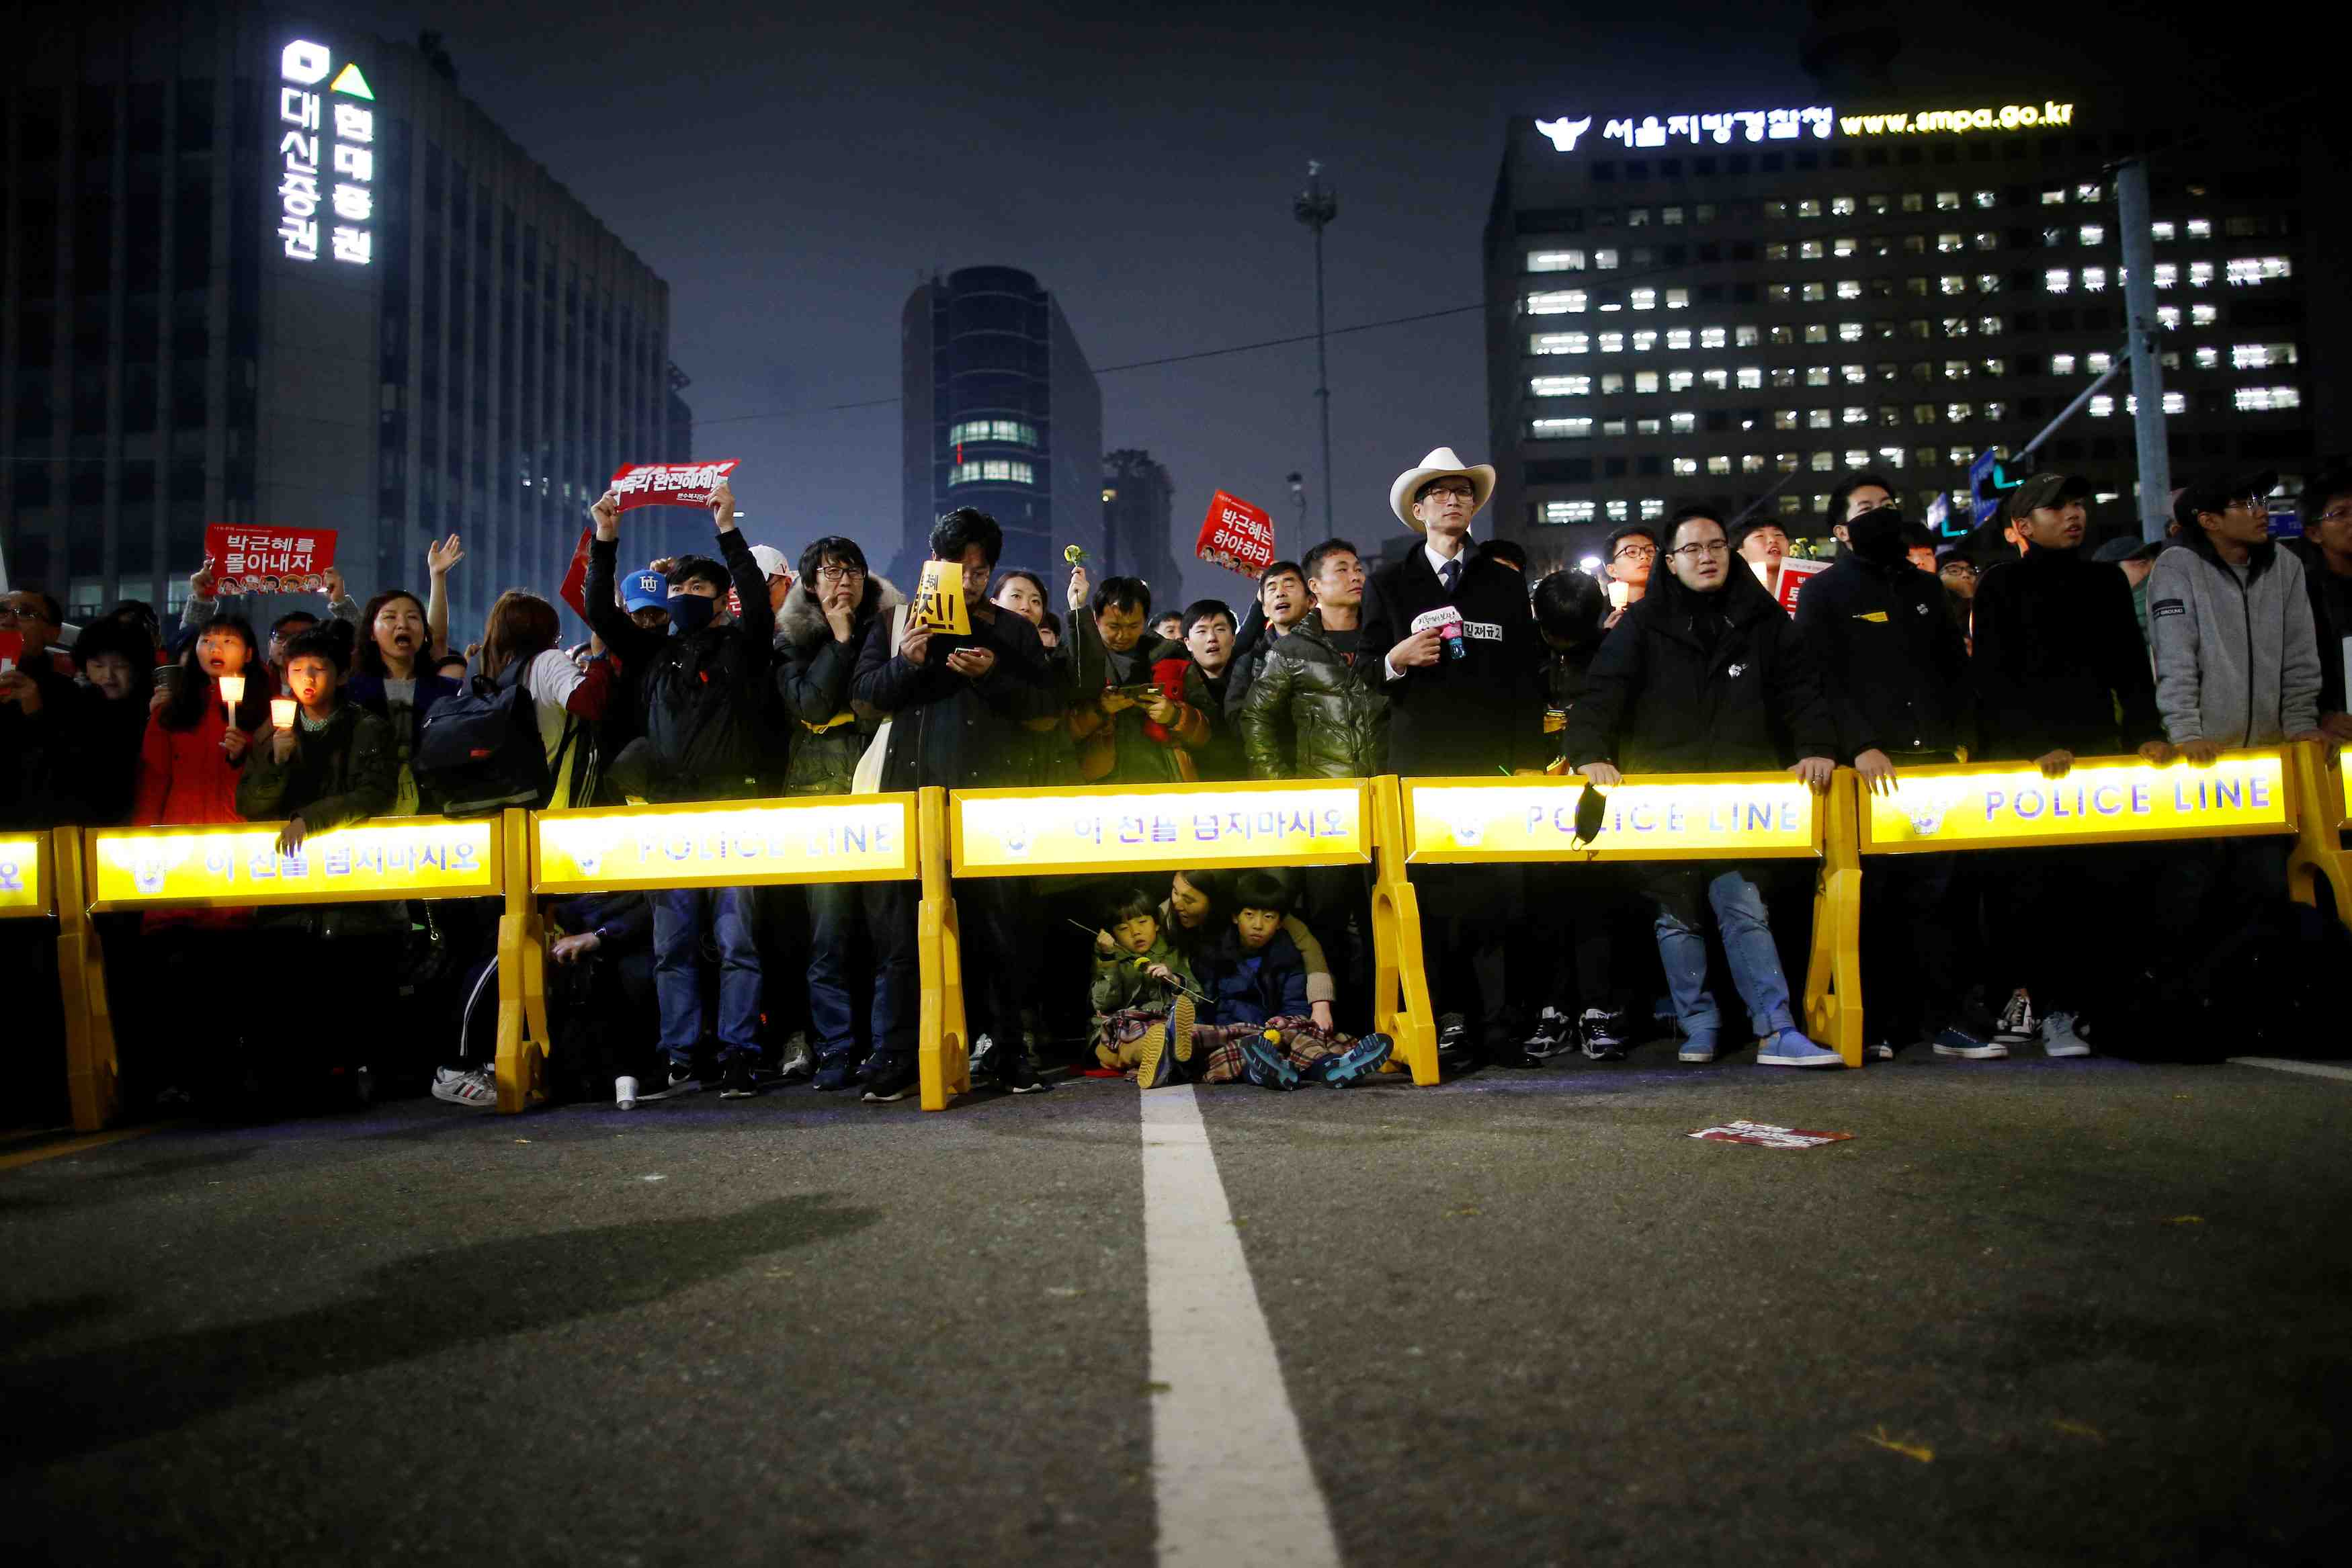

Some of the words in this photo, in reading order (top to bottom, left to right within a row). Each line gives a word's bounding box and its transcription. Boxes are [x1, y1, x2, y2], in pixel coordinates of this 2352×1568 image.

[1603, 106, 1833, 148] 서울지방경찰청
[1840, 101, 2072, 136] www.smpa.go.kr
[278, 87, 321, 262] 대신증권
[226, 535, 316, 552] 박근혜를
[1222, 509, 1272, 546] 박근혜는
[224, 553, 313, 573] 몰아내자
[1214, 529, 1269, 565] 하야하라
[1985, 784, 2150, 820] POLICE
[2173, 776, 2271, 811] LINE
[1074, 816, 1101, 844] 이
[1118, 814, 1177, 843] 선을
[1193, 809, 1349, 842] 넘지마시오
[1526, 803, 1684, 833] POICE
[1708, 801, 1798, 831] LINE
[637, 831, 785, 862] POLICE
[806, 824, 893, 857] LINE
[206, 851, 234, 881] 이
[324, 842, 480, 875] 넘지마시오
